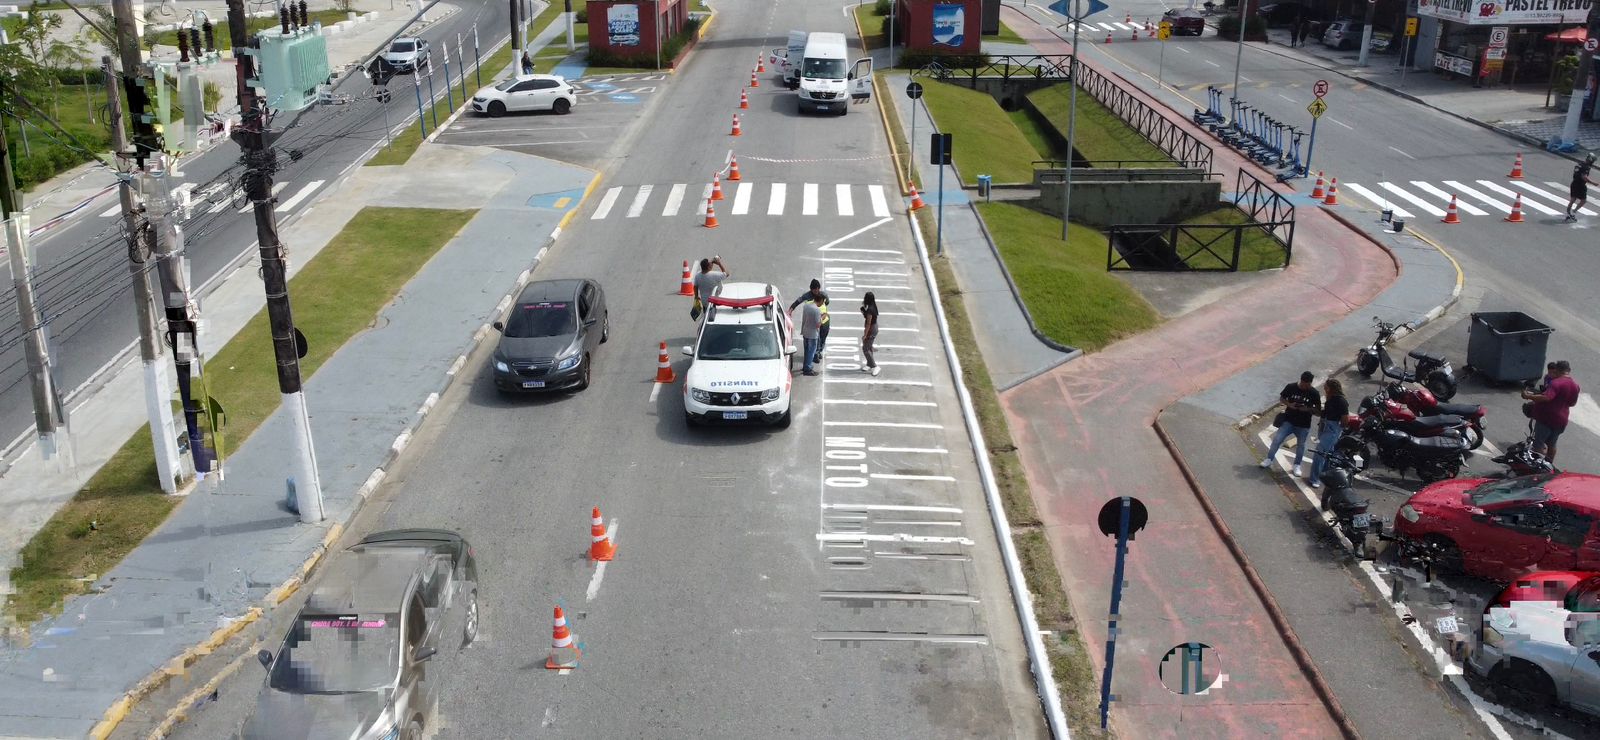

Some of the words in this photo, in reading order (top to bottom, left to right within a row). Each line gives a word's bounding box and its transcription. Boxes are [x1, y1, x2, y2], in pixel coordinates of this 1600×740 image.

[1505, 0, 1549, 11] PASTEL
[824, 267, 854, 292] MOTO
[825, 336, 861, 370] MOTO
[825, 436, 869, 488] MOTO
